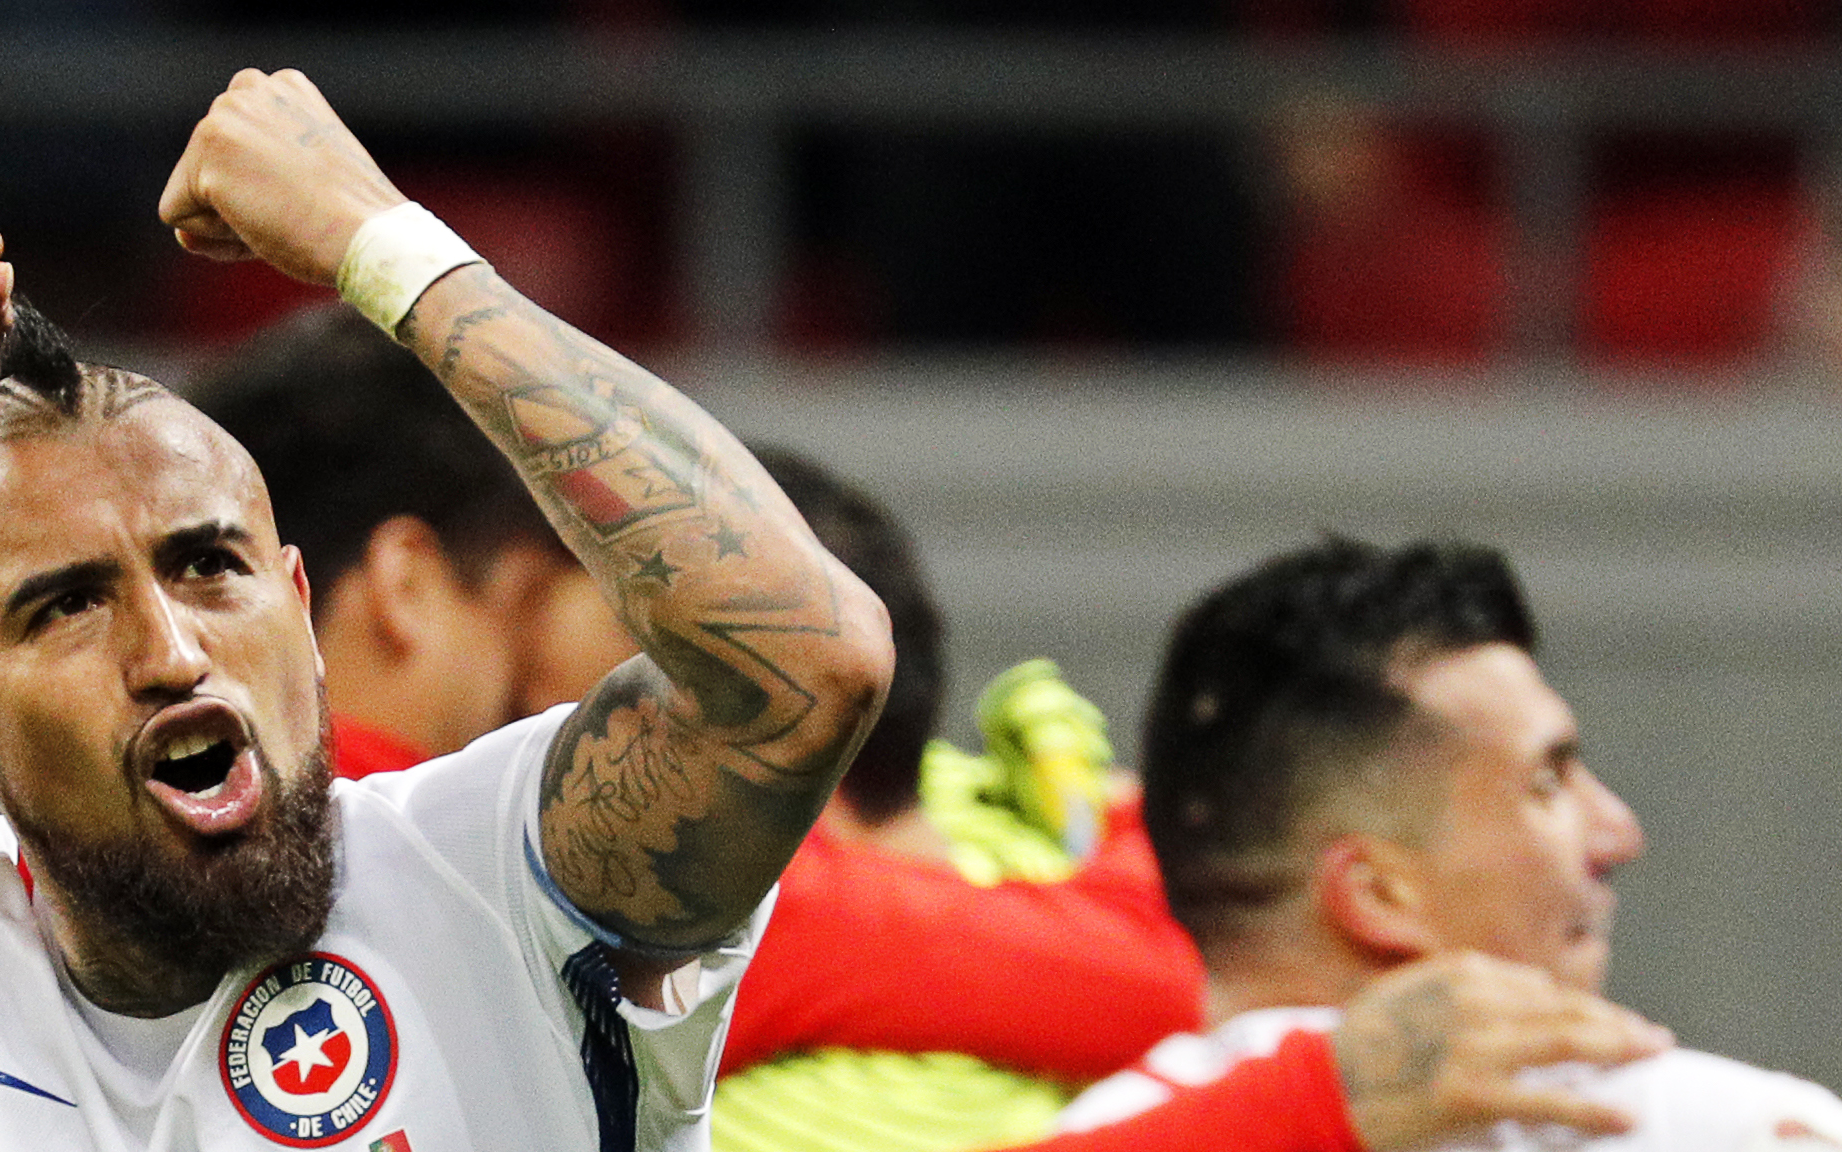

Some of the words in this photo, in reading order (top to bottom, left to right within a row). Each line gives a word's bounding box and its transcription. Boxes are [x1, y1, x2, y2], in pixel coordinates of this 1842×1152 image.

[228, 975, 282, 1089] FEDERACION
[290, 962, 313, 982] DE
[320, 962, 377, 1017] FUTBOL
[298, 1116, 323, 1138] DE
[331, 1083, 377, 1129] CHILE
